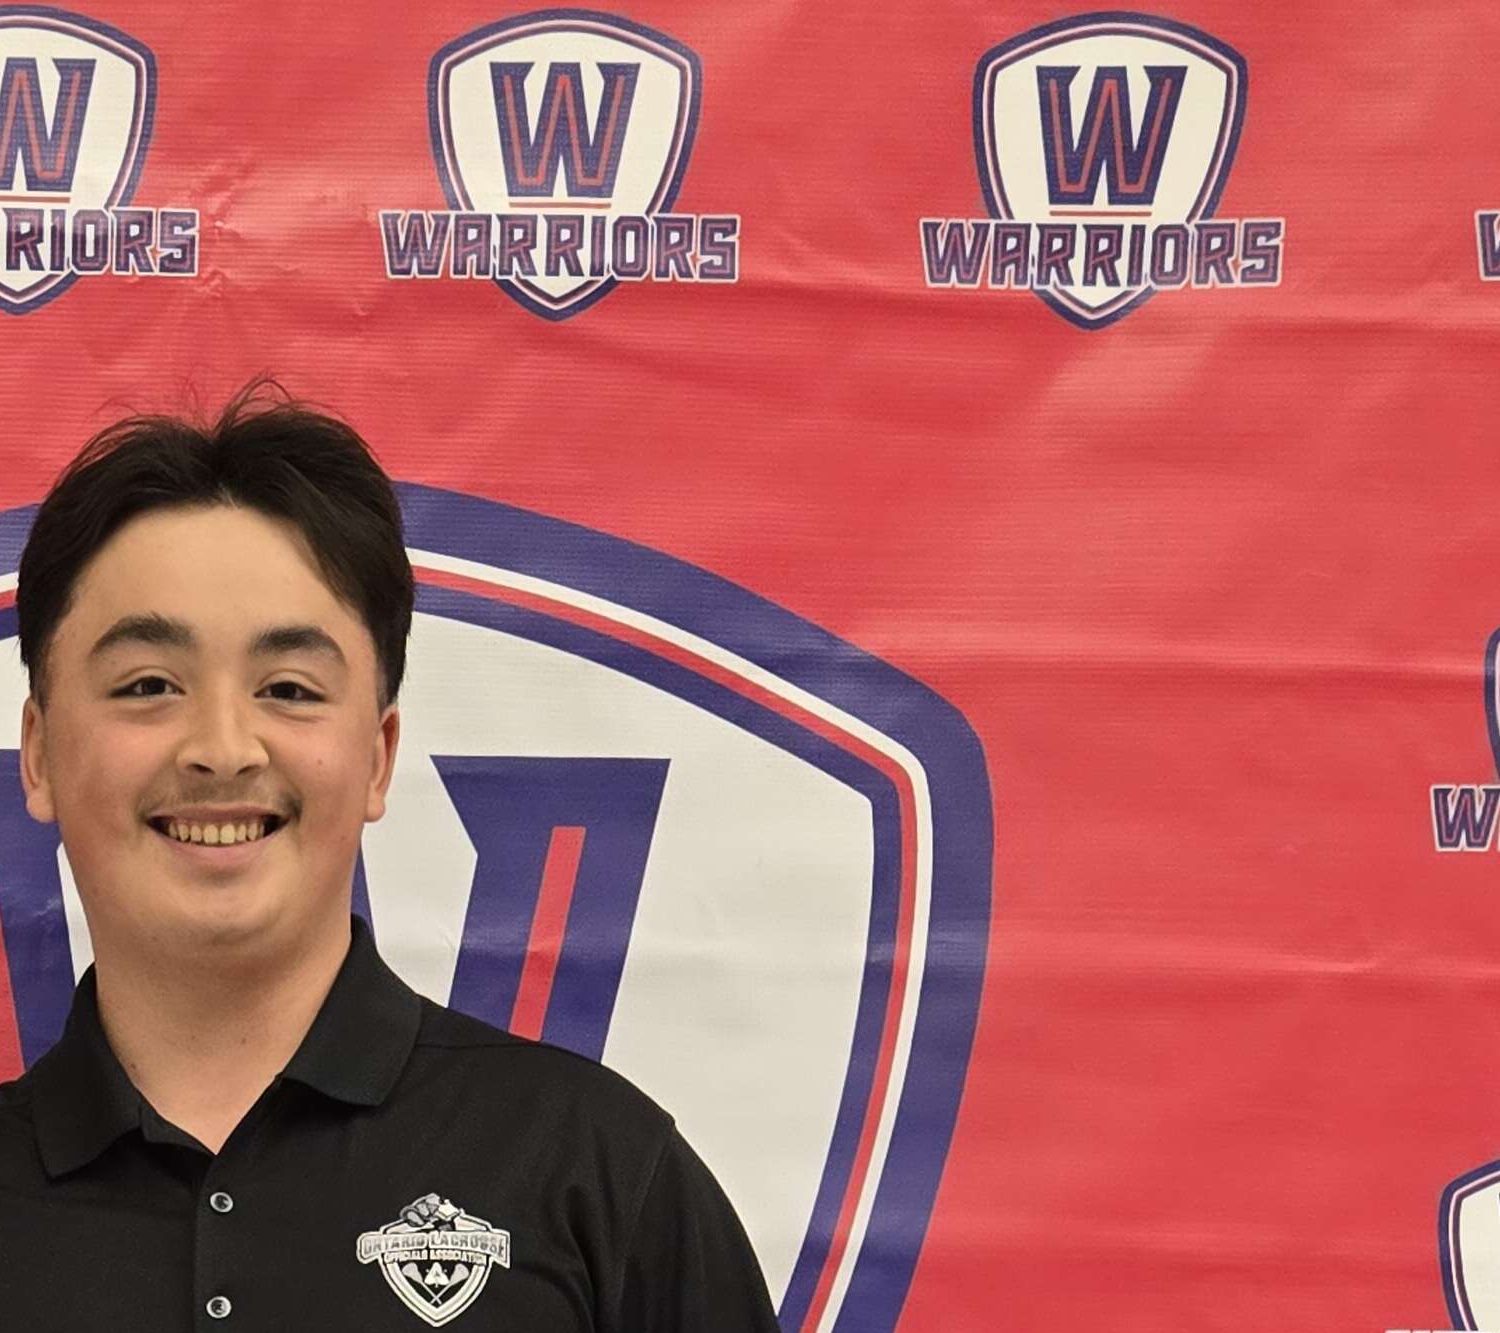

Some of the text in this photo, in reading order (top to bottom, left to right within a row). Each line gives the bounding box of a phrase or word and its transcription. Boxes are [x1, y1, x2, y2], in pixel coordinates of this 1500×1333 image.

[490, 62, 641, 199] W
[1036, 64, 1186, 207] W
[378, 210, 739, 283] WARRIORS
[921, 217, 1285, 289] WARRIORS
